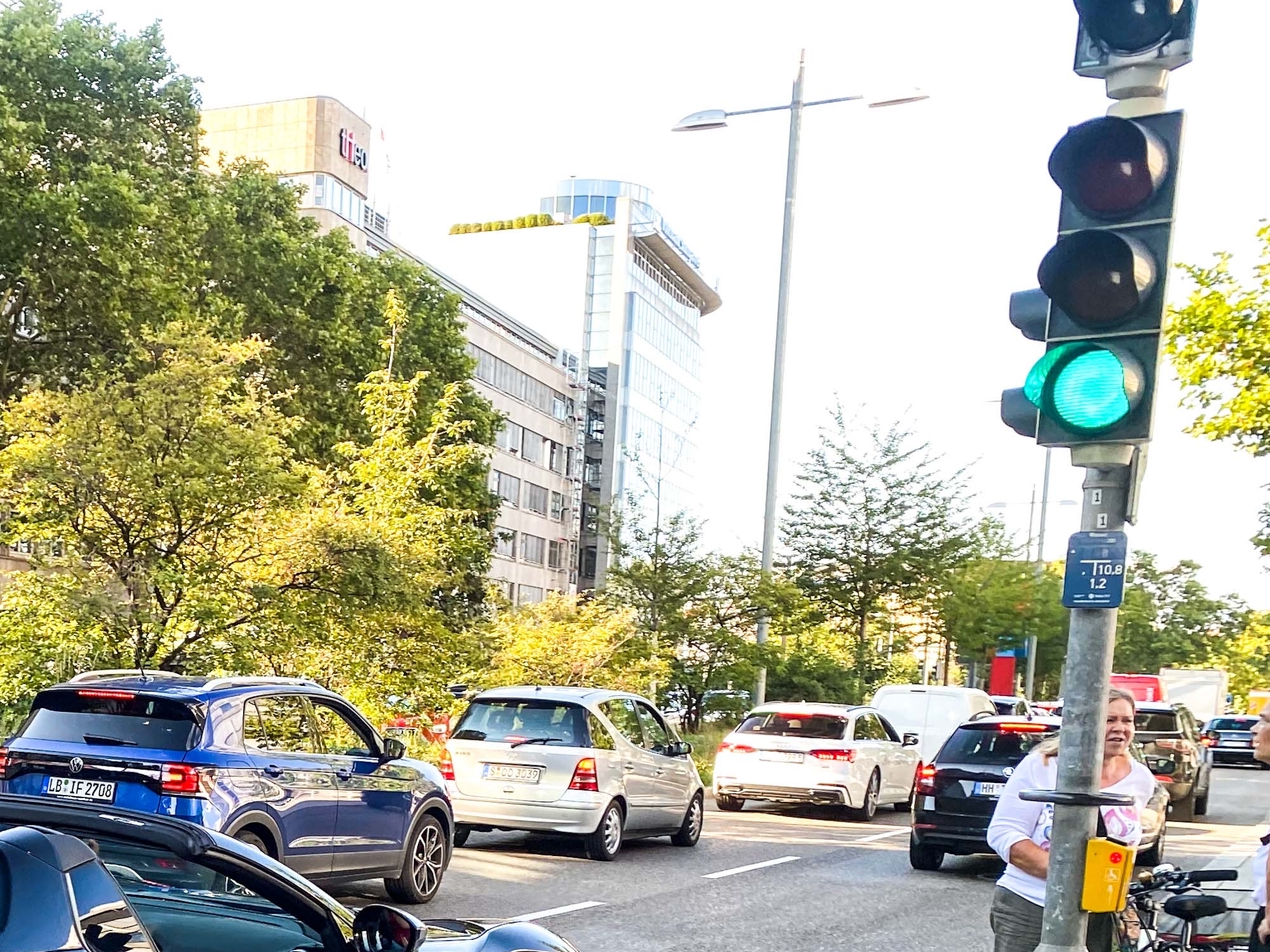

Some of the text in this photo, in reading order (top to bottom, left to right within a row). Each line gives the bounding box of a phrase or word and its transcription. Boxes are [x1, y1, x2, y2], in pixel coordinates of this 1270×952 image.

[49, 778, 112, 798] LB IF 2708
